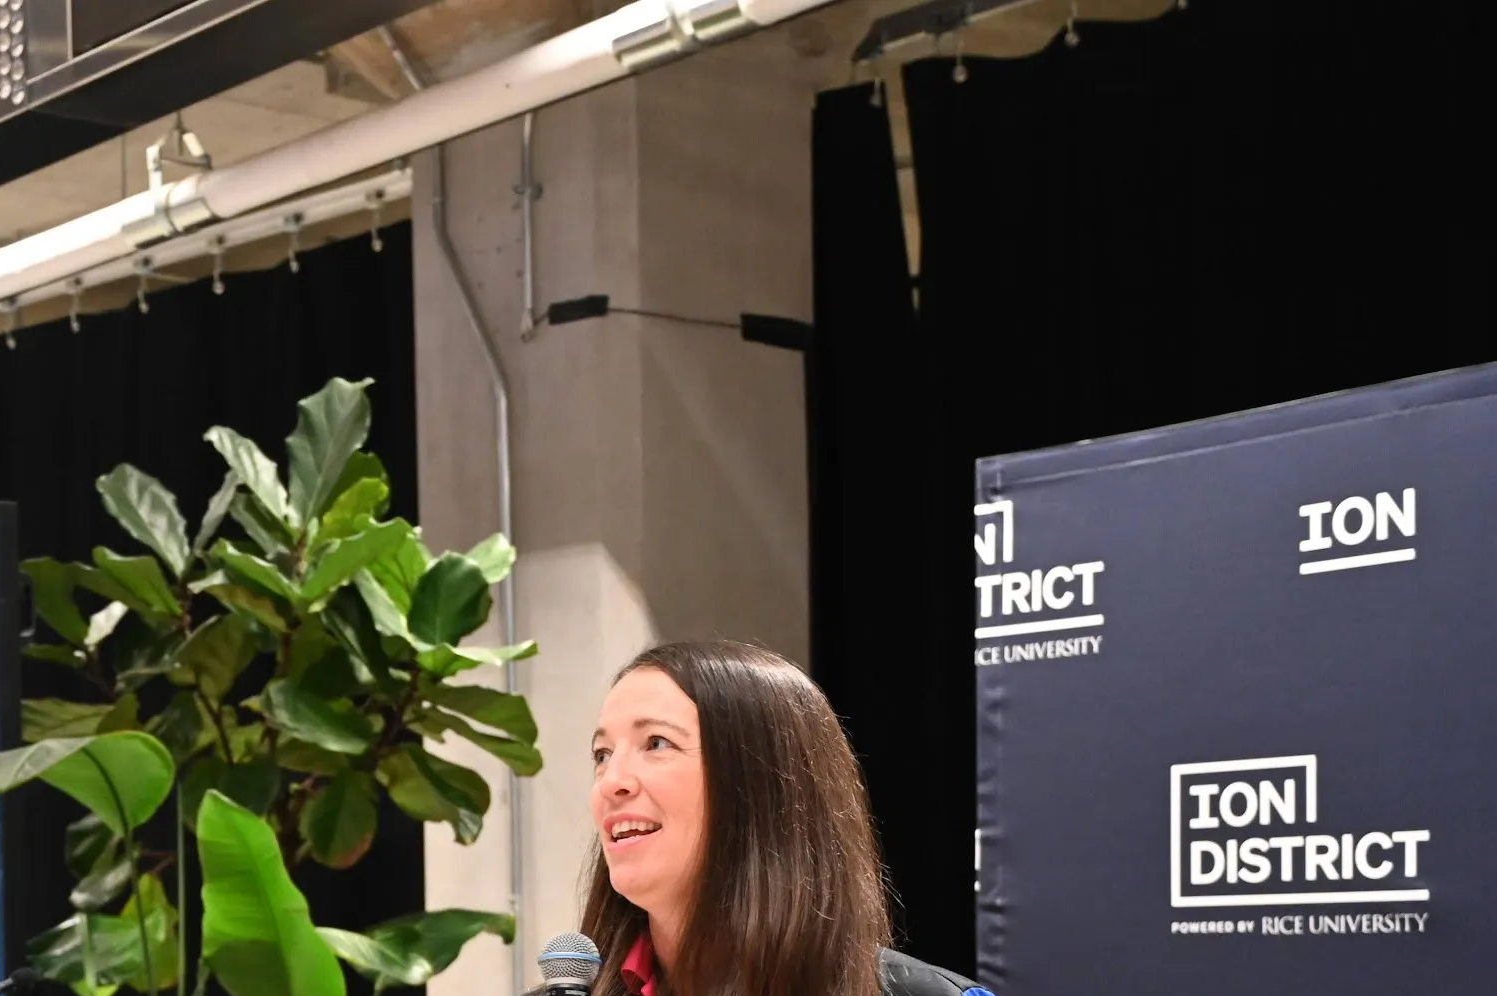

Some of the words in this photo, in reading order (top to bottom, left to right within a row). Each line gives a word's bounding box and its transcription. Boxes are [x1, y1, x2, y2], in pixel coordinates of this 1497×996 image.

[1299, 488, 1417, 553] ION
[1004, 635, 1103, 664] UNIVERSITY
[1189, 778, 1296, 829] ION
[1190, 829, 1430, 885] DISTRICT
[1170, 920, 1235, 935] POWERED
[1237, 919, 1255, 934] BY
[1261, 914, 1304, 936] RICE
[1308, 911, 1429, 936] UNIVERSITY
